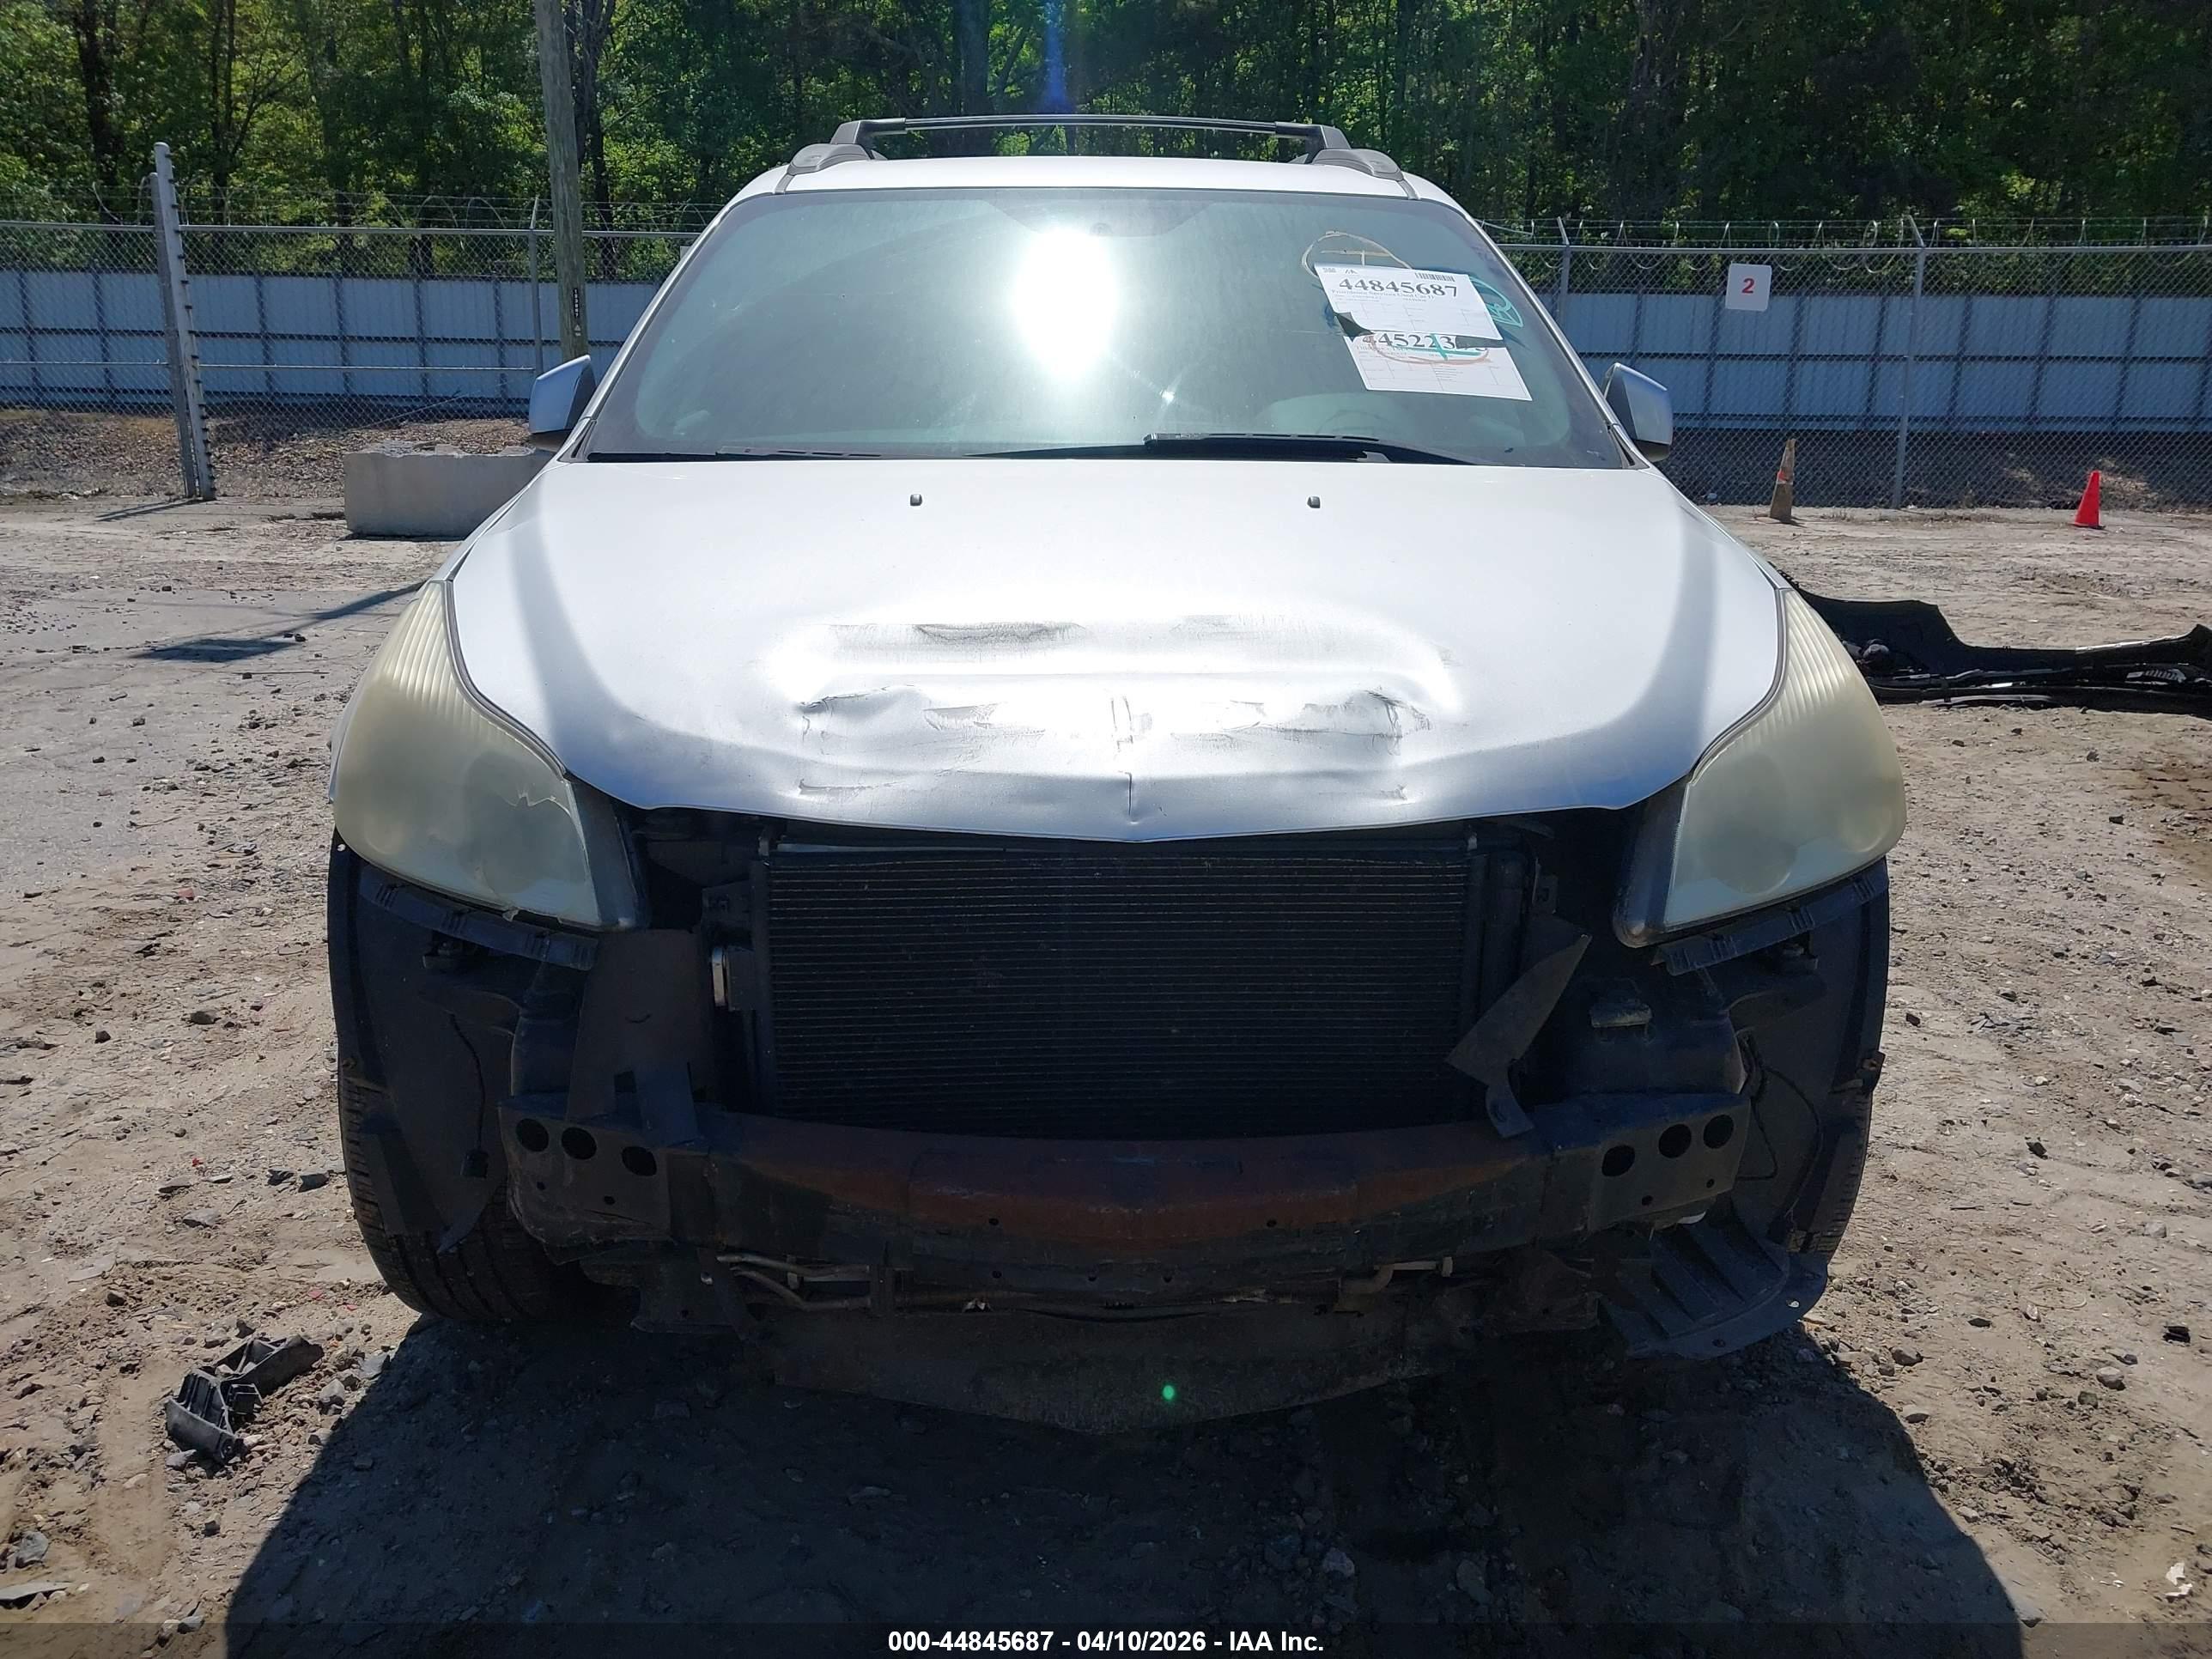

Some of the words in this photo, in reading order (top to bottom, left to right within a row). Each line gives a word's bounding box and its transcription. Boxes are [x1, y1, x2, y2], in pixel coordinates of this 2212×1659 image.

[1339, 278, 1457, 297] 44845687
[1741, 277, 1755, 294] 2
[1363, 333, 1487, 351] 445223
